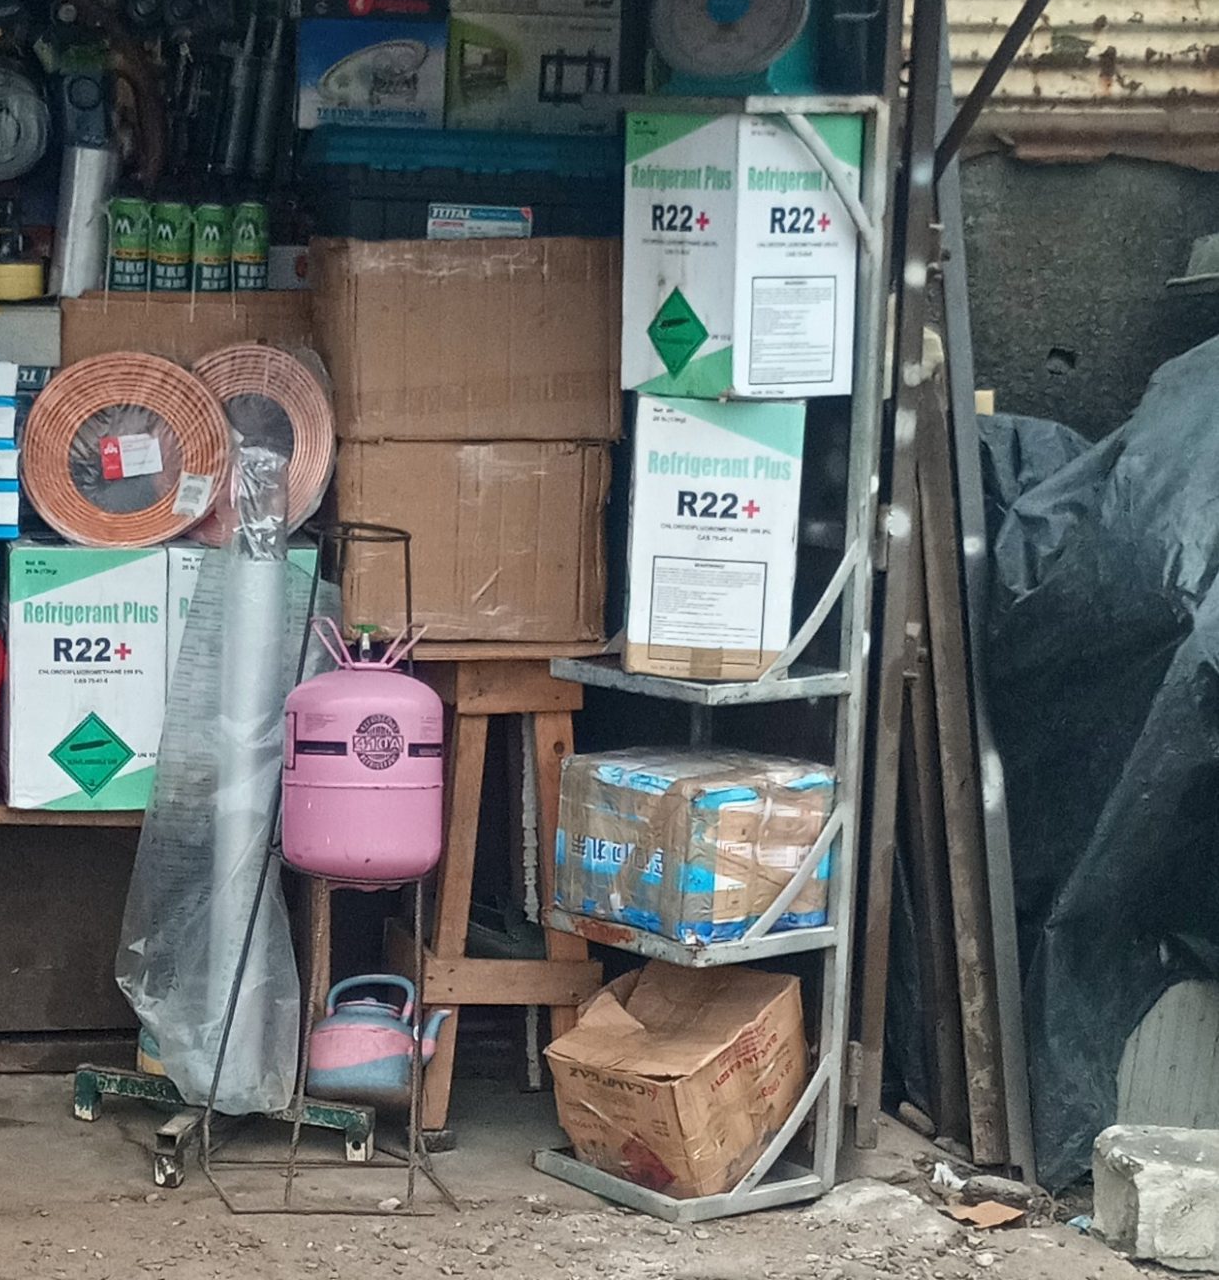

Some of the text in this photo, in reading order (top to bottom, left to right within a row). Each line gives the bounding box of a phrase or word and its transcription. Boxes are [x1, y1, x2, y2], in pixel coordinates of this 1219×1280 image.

[631, 164, 732, 192] Refrigerant Plus
[748, 165, 823, 194] Refrigerant
[647, 449, 792, 481] Refrigerant Plus
[23, 601, 119, 626] Refrigerant
[123, 601, 159, 624] Plus
[355, 736, 401, 751] 410A
